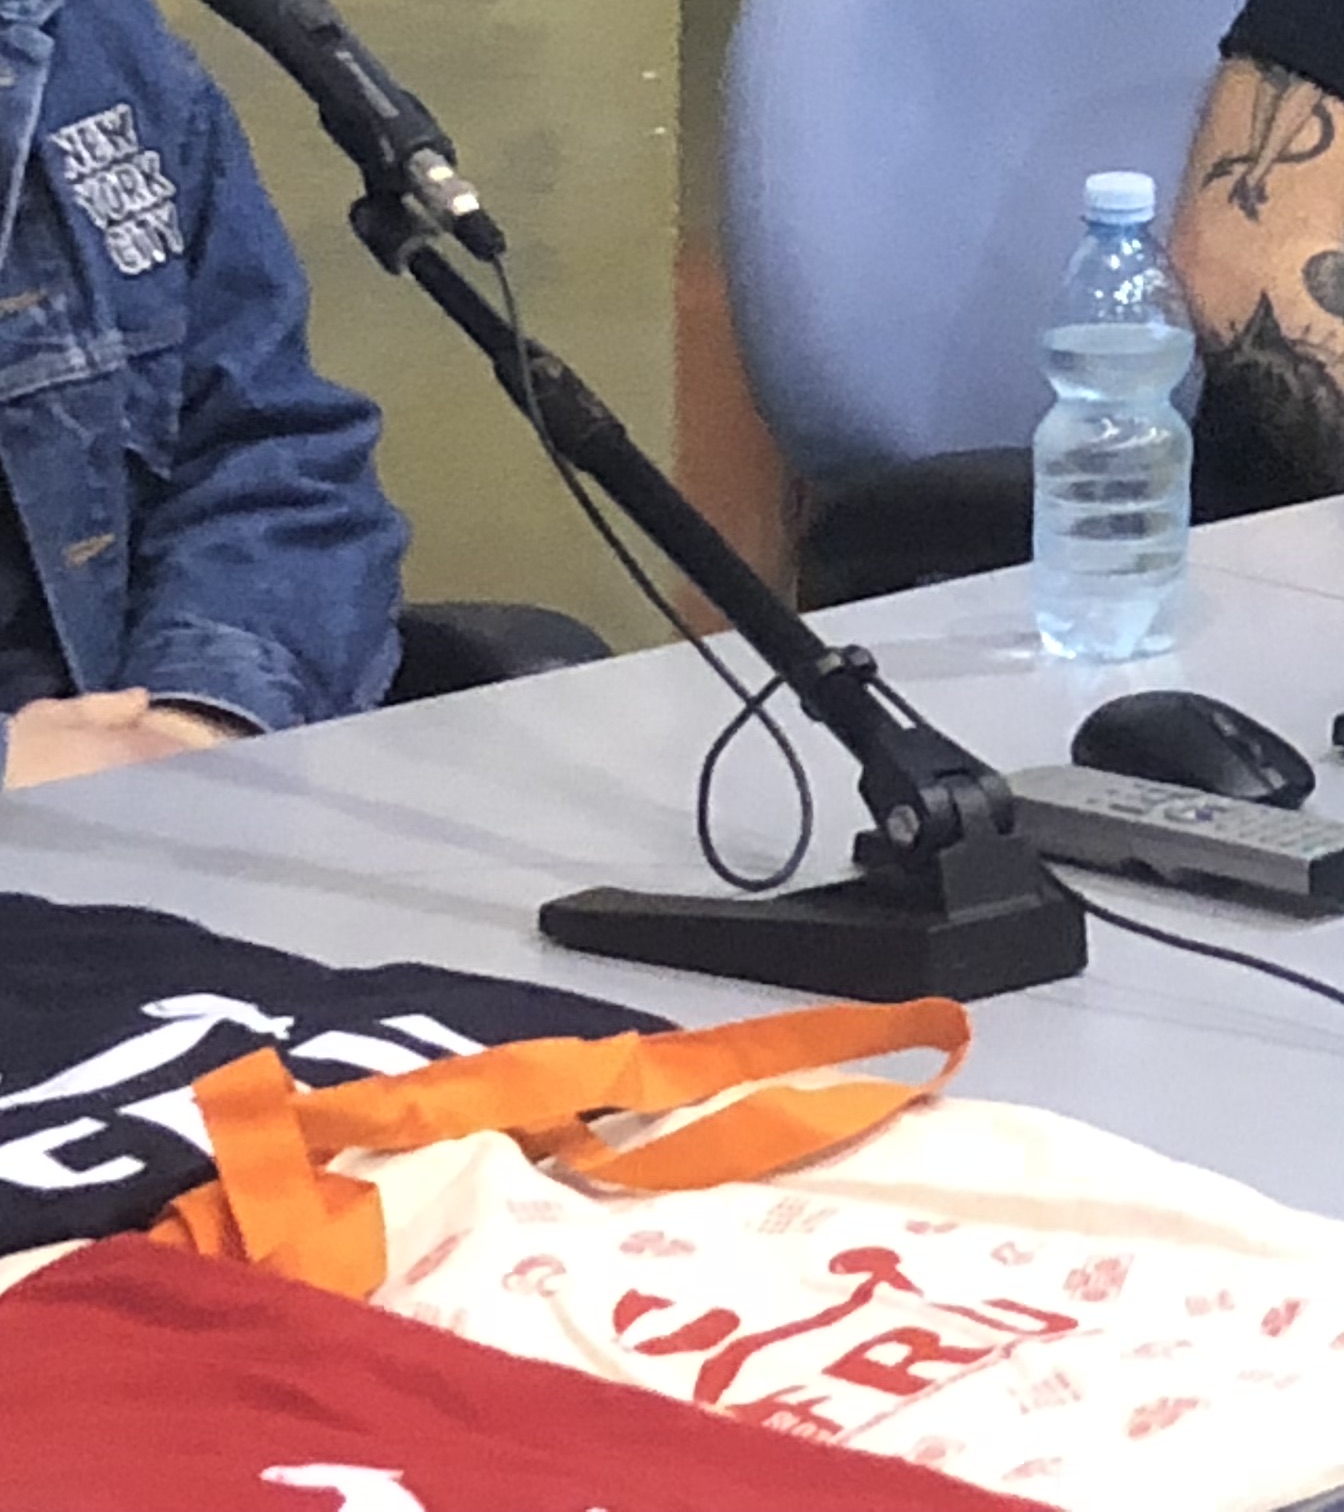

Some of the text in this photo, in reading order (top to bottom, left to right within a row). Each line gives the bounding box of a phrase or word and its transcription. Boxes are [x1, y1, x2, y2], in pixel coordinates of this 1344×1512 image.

[50, 103, 139, 180] NEW
[74, 150, 177, 230] YORK
[105, 199, 185, 275] CITY
